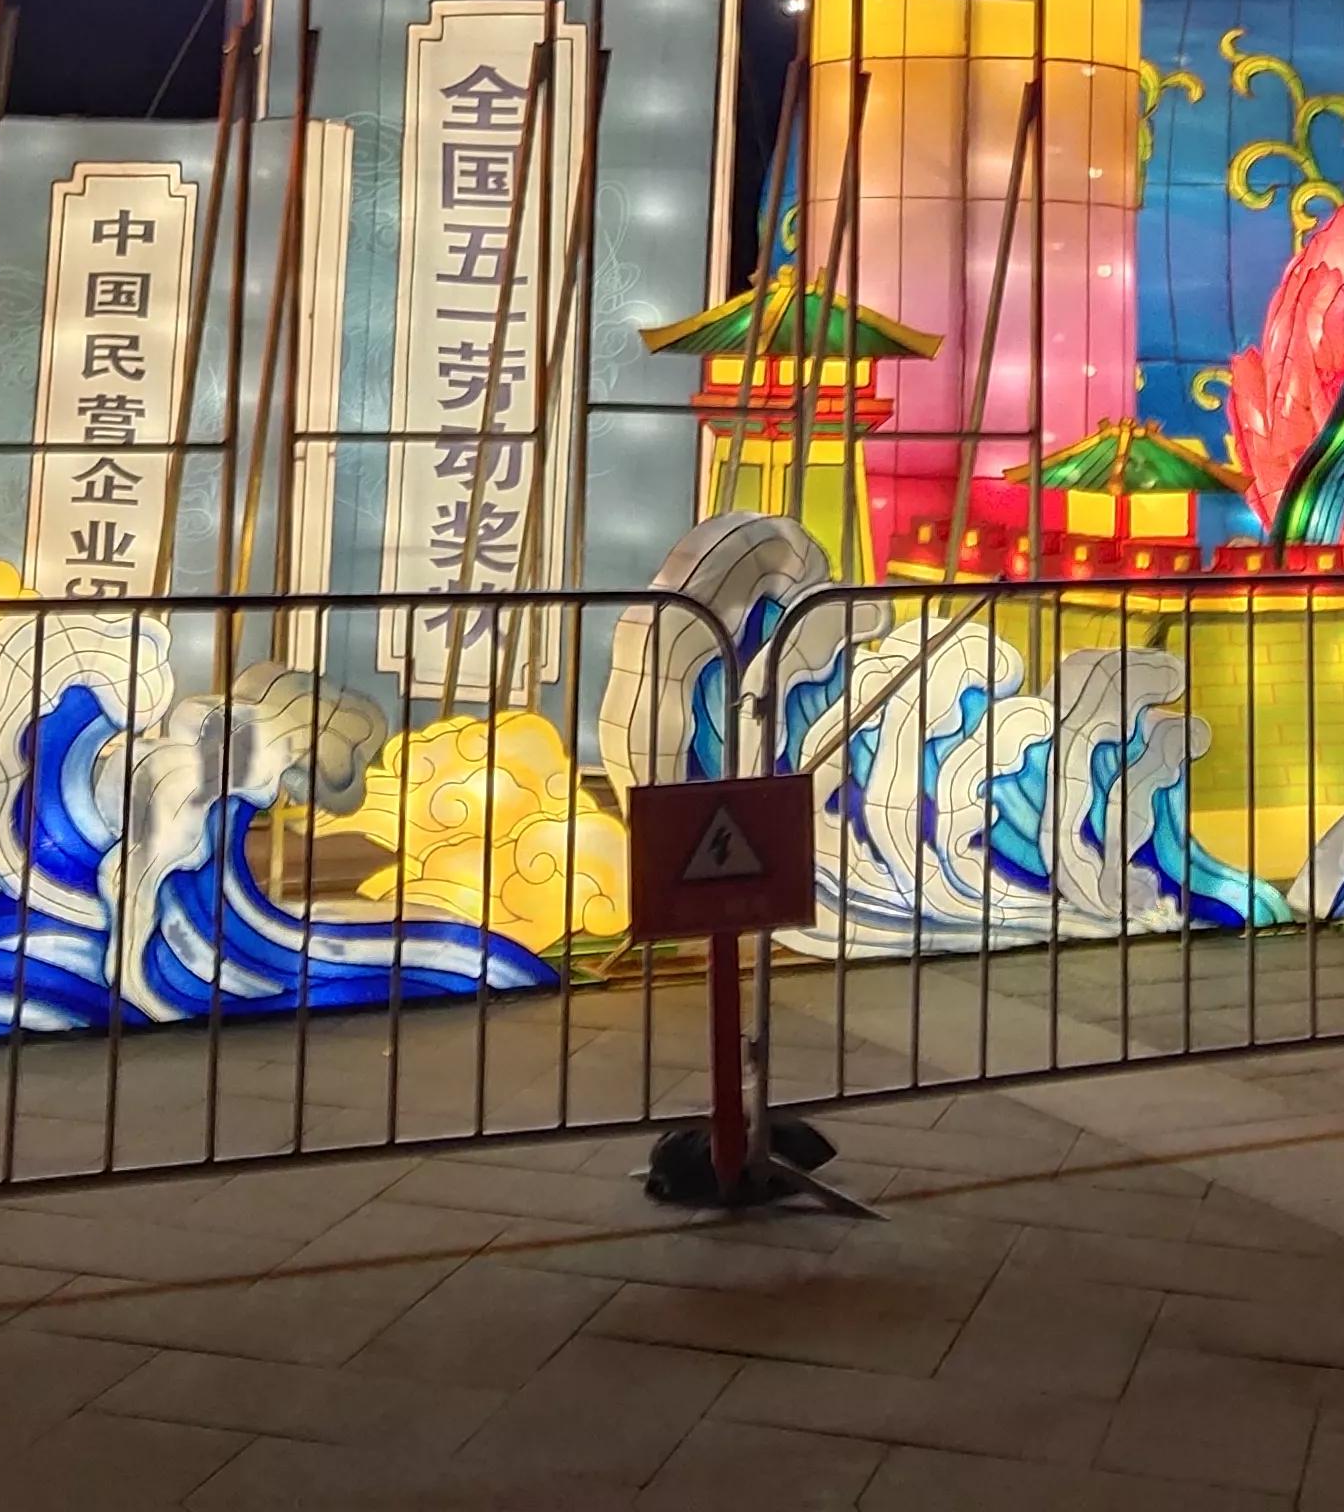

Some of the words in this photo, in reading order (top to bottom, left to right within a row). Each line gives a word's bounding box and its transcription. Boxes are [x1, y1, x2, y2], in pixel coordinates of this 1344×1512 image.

[423, 64, 531, 652] 全国五一劳动奖状
